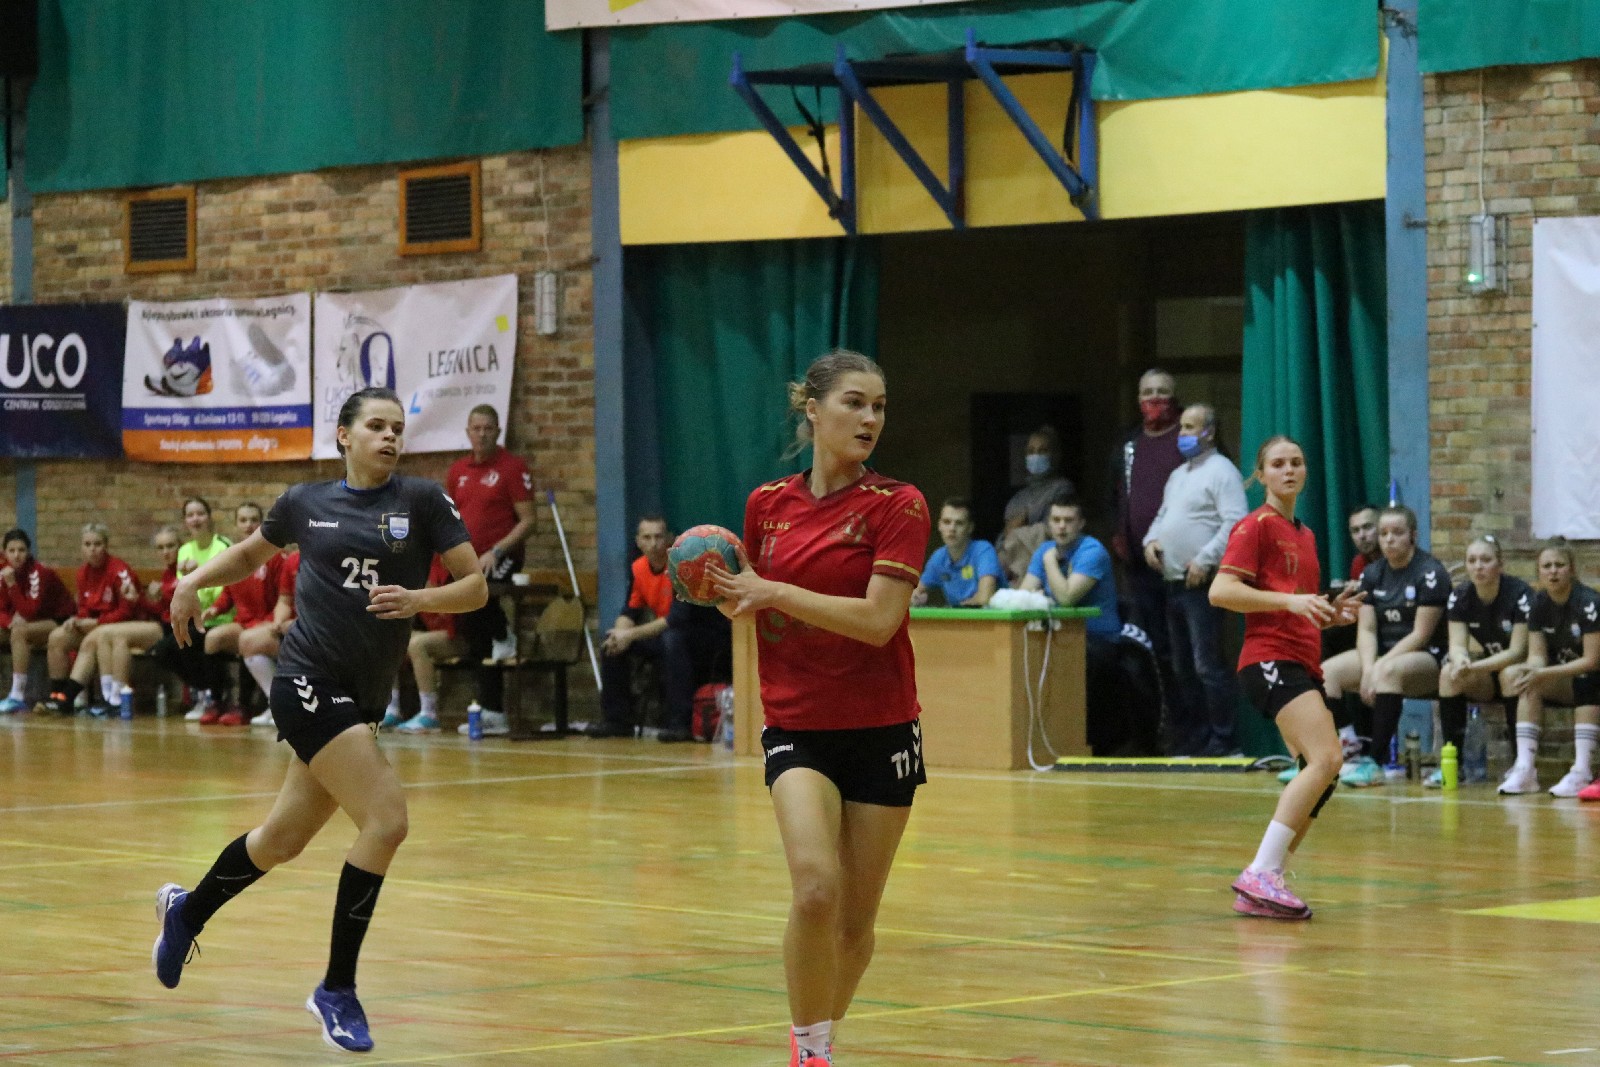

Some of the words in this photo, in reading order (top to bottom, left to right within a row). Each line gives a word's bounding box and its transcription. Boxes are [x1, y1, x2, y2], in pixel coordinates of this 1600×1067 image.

[0, 333, 88, 389] UCO
[428, 344, 499, 378] LEGNICA
[308, 518, 339, 528] hummel
[341, 557, 380, 591] 25
[1384, 609, 1402, 622] 10
[766, 742, 794, 758] hummel
